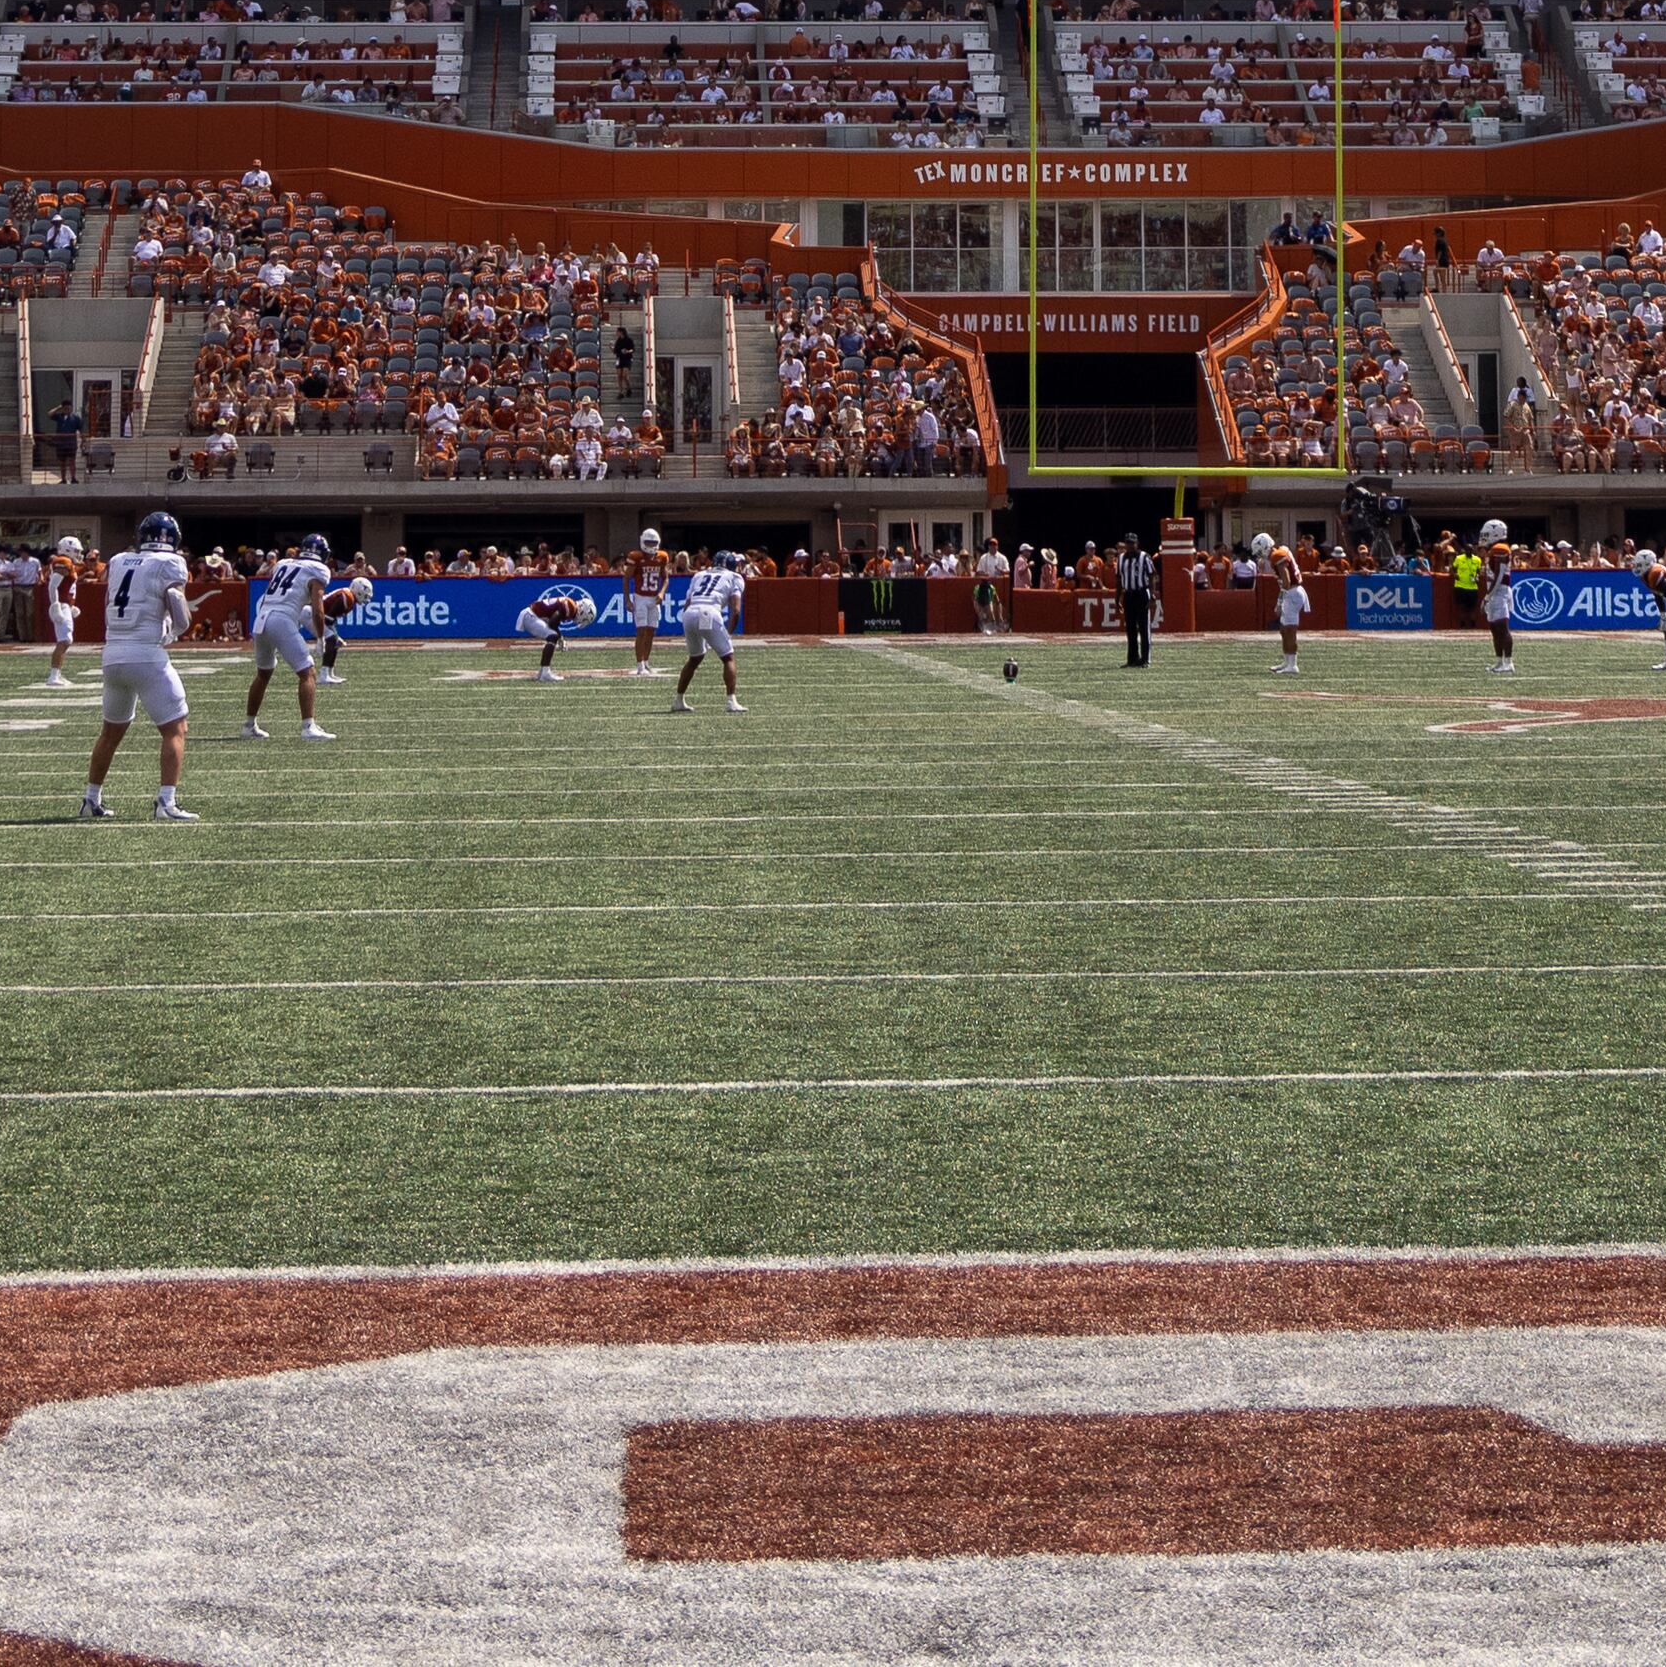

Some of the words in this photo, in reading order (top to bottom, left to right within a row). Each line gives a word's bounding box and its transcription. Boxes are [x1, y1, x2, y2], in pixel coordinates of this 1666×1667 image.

[914, 161, 946, 184] TEX
[950, 163, 1064, 183] MONCREF
[1084, 163, 1188, 182] COMPLEX
[1148, 315, 1199, 332] FIELD
[266, 566, 301, 595] 84
[641, 573, 659, 591] 15
[693, 575, 721, 596] 31
[114, 569, 135, 618] 4
[1356, 586, 1422, 609] DELL
[1358, 613, 1423, 625] Technologies
